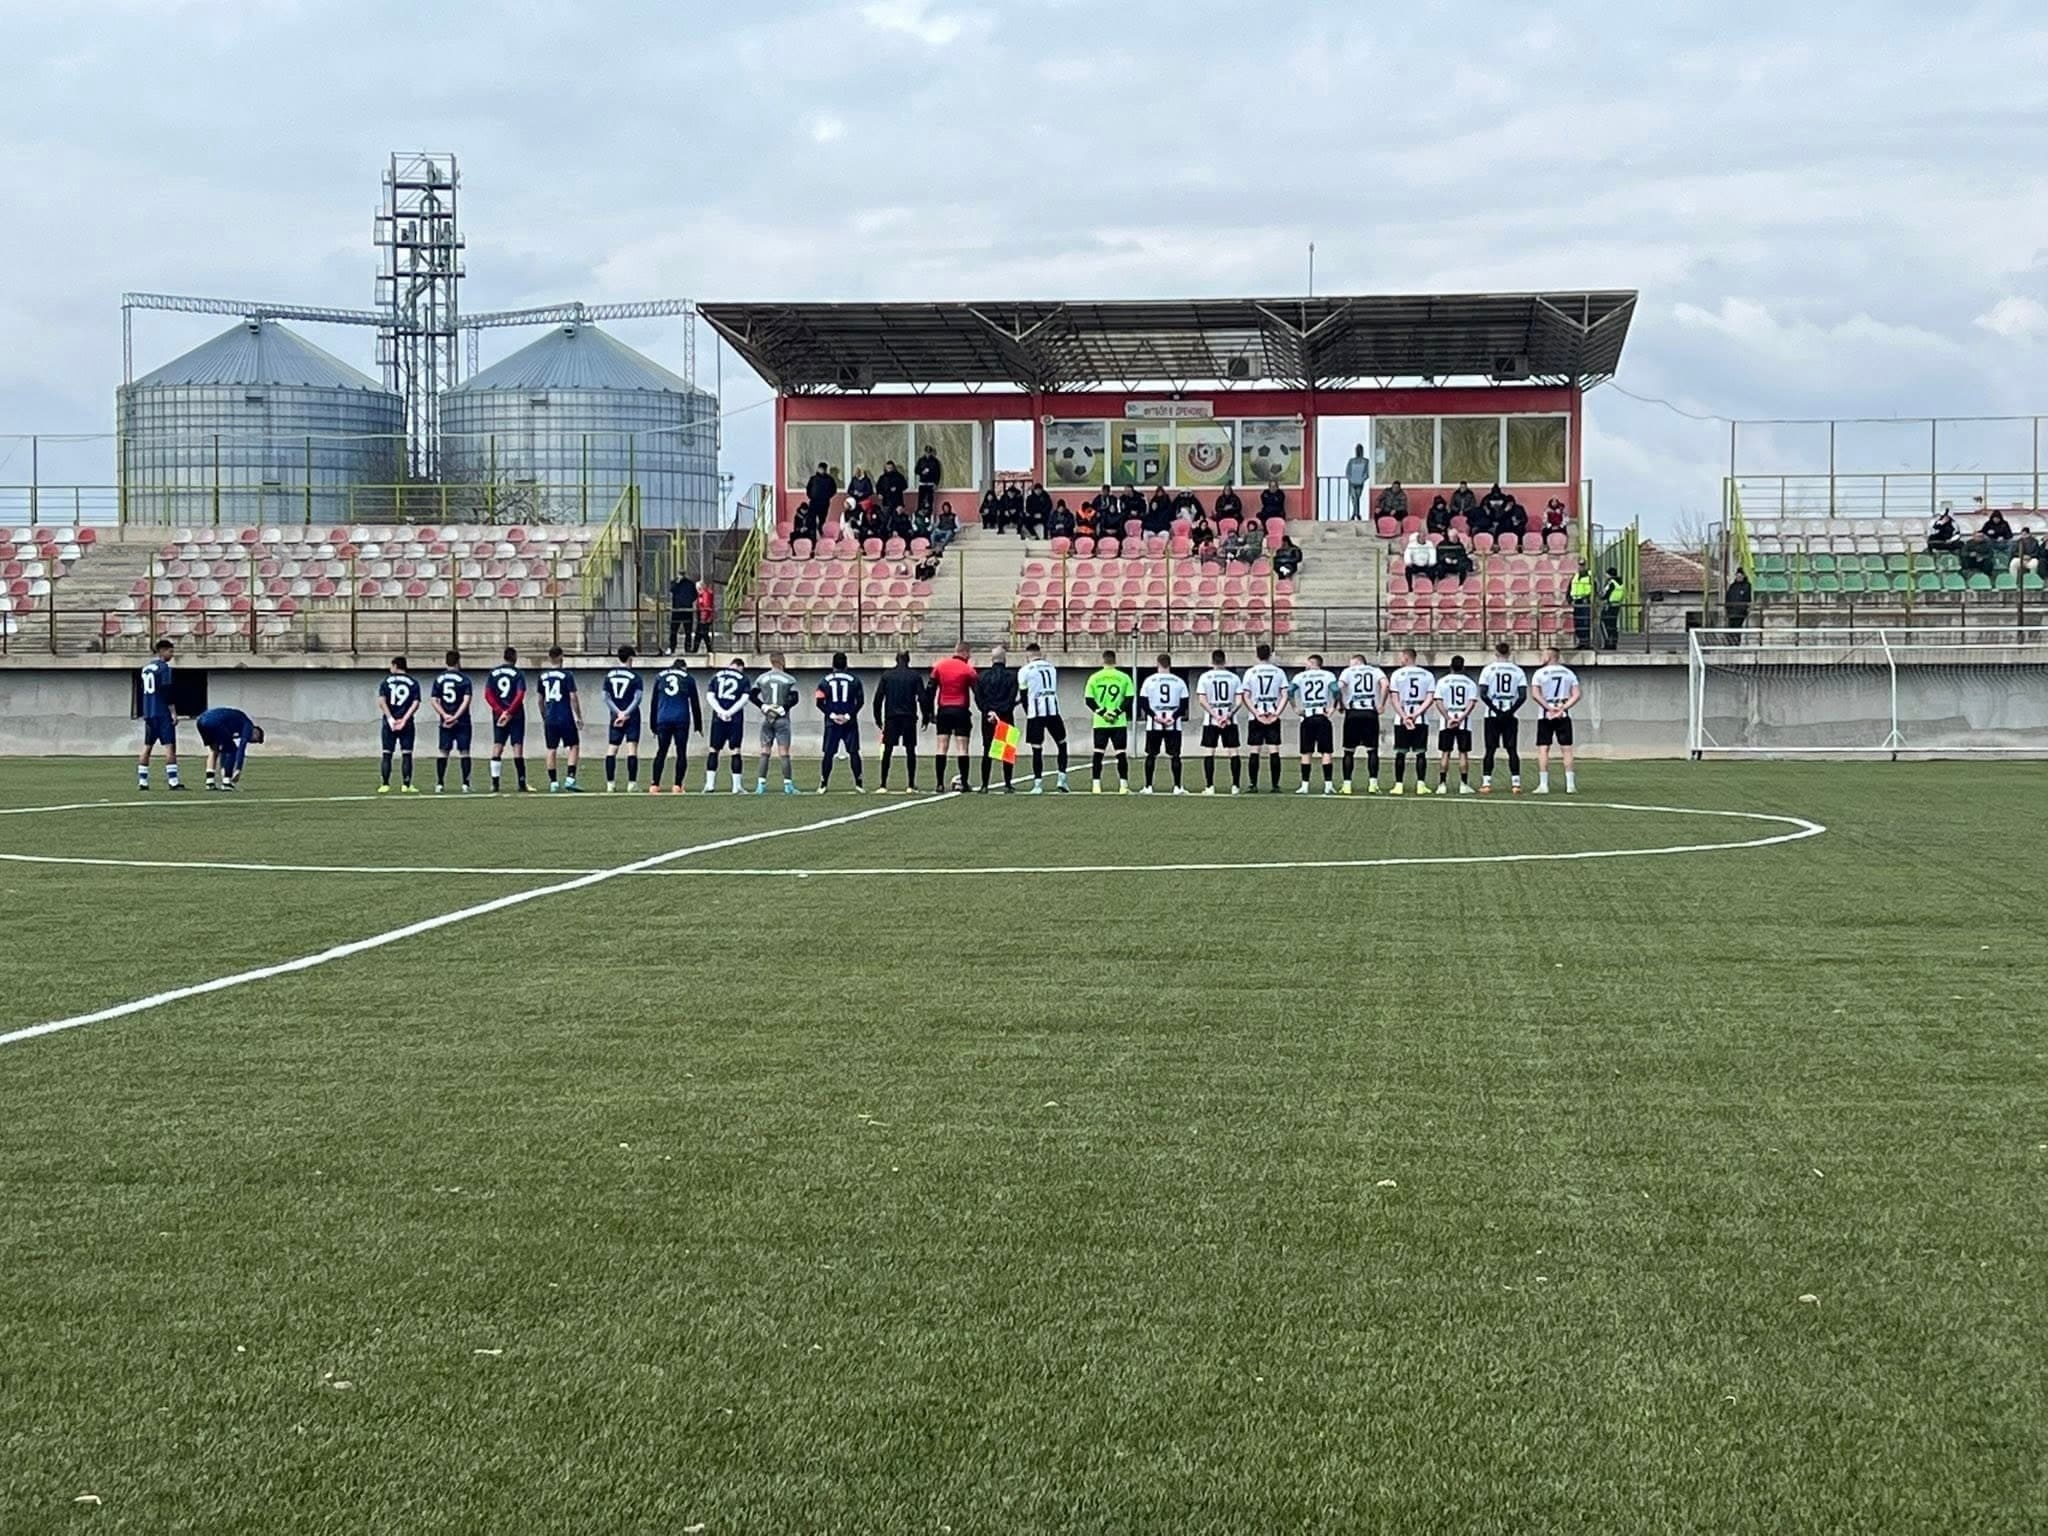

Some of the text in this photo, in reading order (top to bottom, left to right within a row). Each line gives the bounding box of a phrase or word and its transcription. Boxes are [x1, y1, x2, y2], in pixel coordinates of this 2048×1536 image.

[498, 676, 511, 698] 9
[609, 678, 630, 699] 17
[664, 675, 680, 696] 3
[717, 677, 736, 700] 12
[1038, 670, 1052, 689] 11
[1257, 675, 1273, 695] 17
[1354, 673, 1373, 693] 20
[1409, 678, 1419, 698] 5
[1496, 673, 1512, 693] 18
[1552, 677, 1562, 697] 7
[389, 683, 410, 706] 19
[443, 682, 456, 703] 5
[543, 680, 562, 702] 14
[770, 683, 778, 705] 1
[829, 681, 848, 702] 11
[1097, 684, 1120, 702] 79
[1160, 684, 1170, 704] 9
[1213, 681, 1229, 701] 10
[1304, 680, 1324, 700] 22
[1450, 685, 1465, 705] 19
